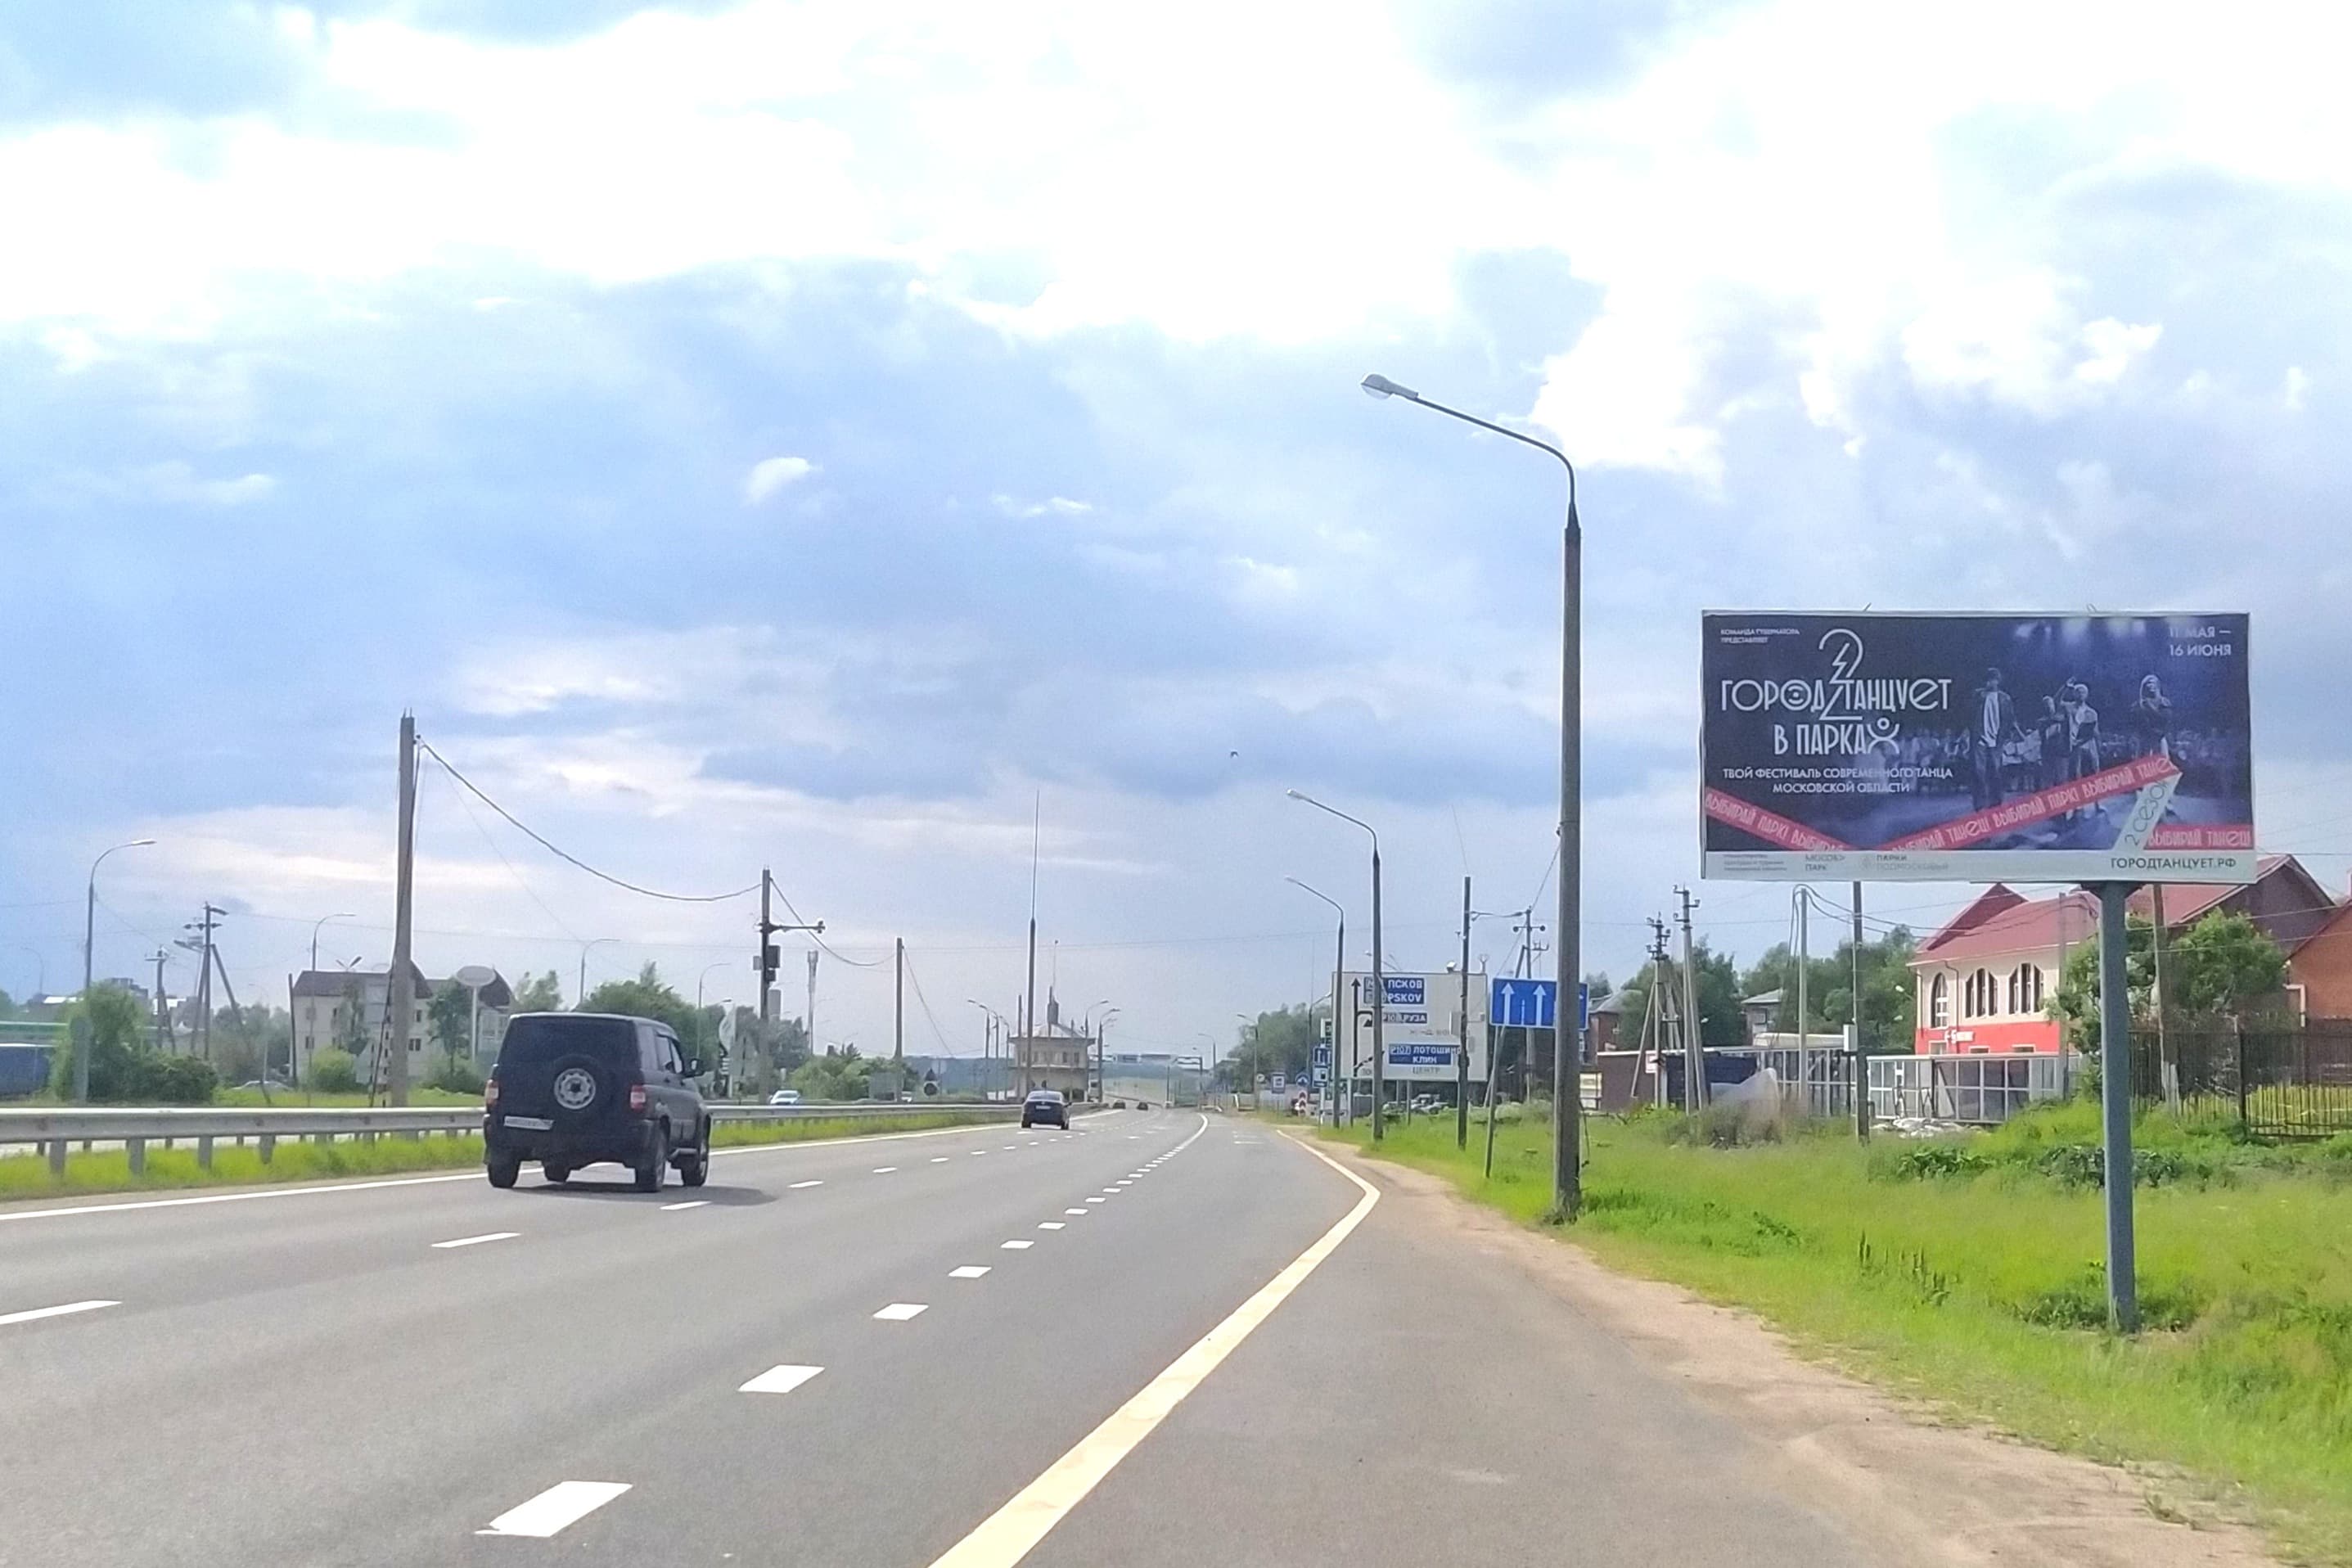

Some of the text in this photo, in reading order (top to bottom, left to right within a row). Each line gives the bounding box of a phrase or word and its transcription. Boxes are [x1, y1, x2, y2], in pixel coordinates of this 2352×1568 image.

[2170, 643, 2232, 656] 16 ИЮНЯ
[1721, 679, 1825, 713] ГОРОД
[1774, 724, 1789, 755] В
[1723, 766, 1953, 780] ТВОЙ ФЕСТИВАЛЬ СОВРЕМЕННОГО ТАНЦА
[1773, 781, 1910, 793] МОСКОВСКОЙ ОБЛАСТИ
[1993, 795, 2046, 827] ВЫБИРАЙ
[2083, 766, 2135, 798] ВЫБИРАЙ
[2111, 857, 2237, 871] ГОРОДТАНЦУЕТ.РФ
[1388, 980, 1422, 989] ПСКОВ
[1387, 993, 1422, 1003] PSKOV
[1413, 1056, 1438, 1064] КЛИН
